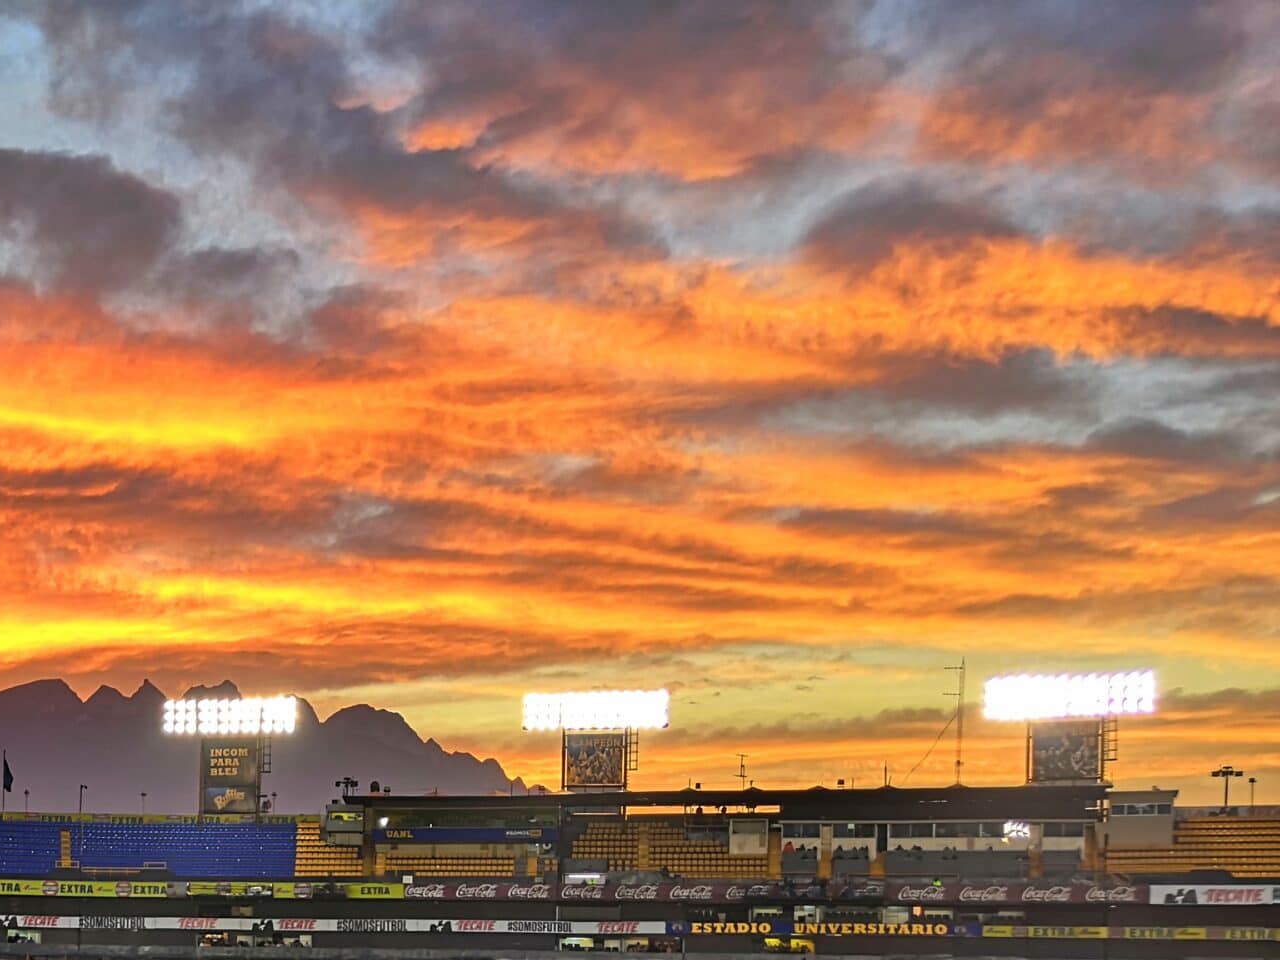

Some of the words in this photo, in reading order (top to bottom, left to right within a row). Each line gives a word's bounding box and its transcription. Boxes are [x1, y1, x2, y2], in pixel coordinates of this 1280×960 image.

[210, 748, 248, 757] INCOM
[210, 758, 240, 766] PARA
[210, 767, 238, 776] BLES
[60, 883, 94, 894] EXTRA
[134, 885, 167, 895] EXTRA
[360, 886, 390, 895] EXTRA
[22, 916, 59, 926] TECATE
[79, 916, 146, 929] #SOMOSFUTBOL
[178, 918, 218, 929] TECATE
[278, 919, 317, 930] TECATE
[337, 920, 408, 932] #SOMOSFUTBOL
[455, 920, 497, 931] TECATE
[508, 920, 573, 933] #SOMOSFUTBOL
[596, 922, 640, 933] TECATE
[691, 922, 772, 934] ESTADIO
[793, 923, 948, 935] UNIVERSITARIO
